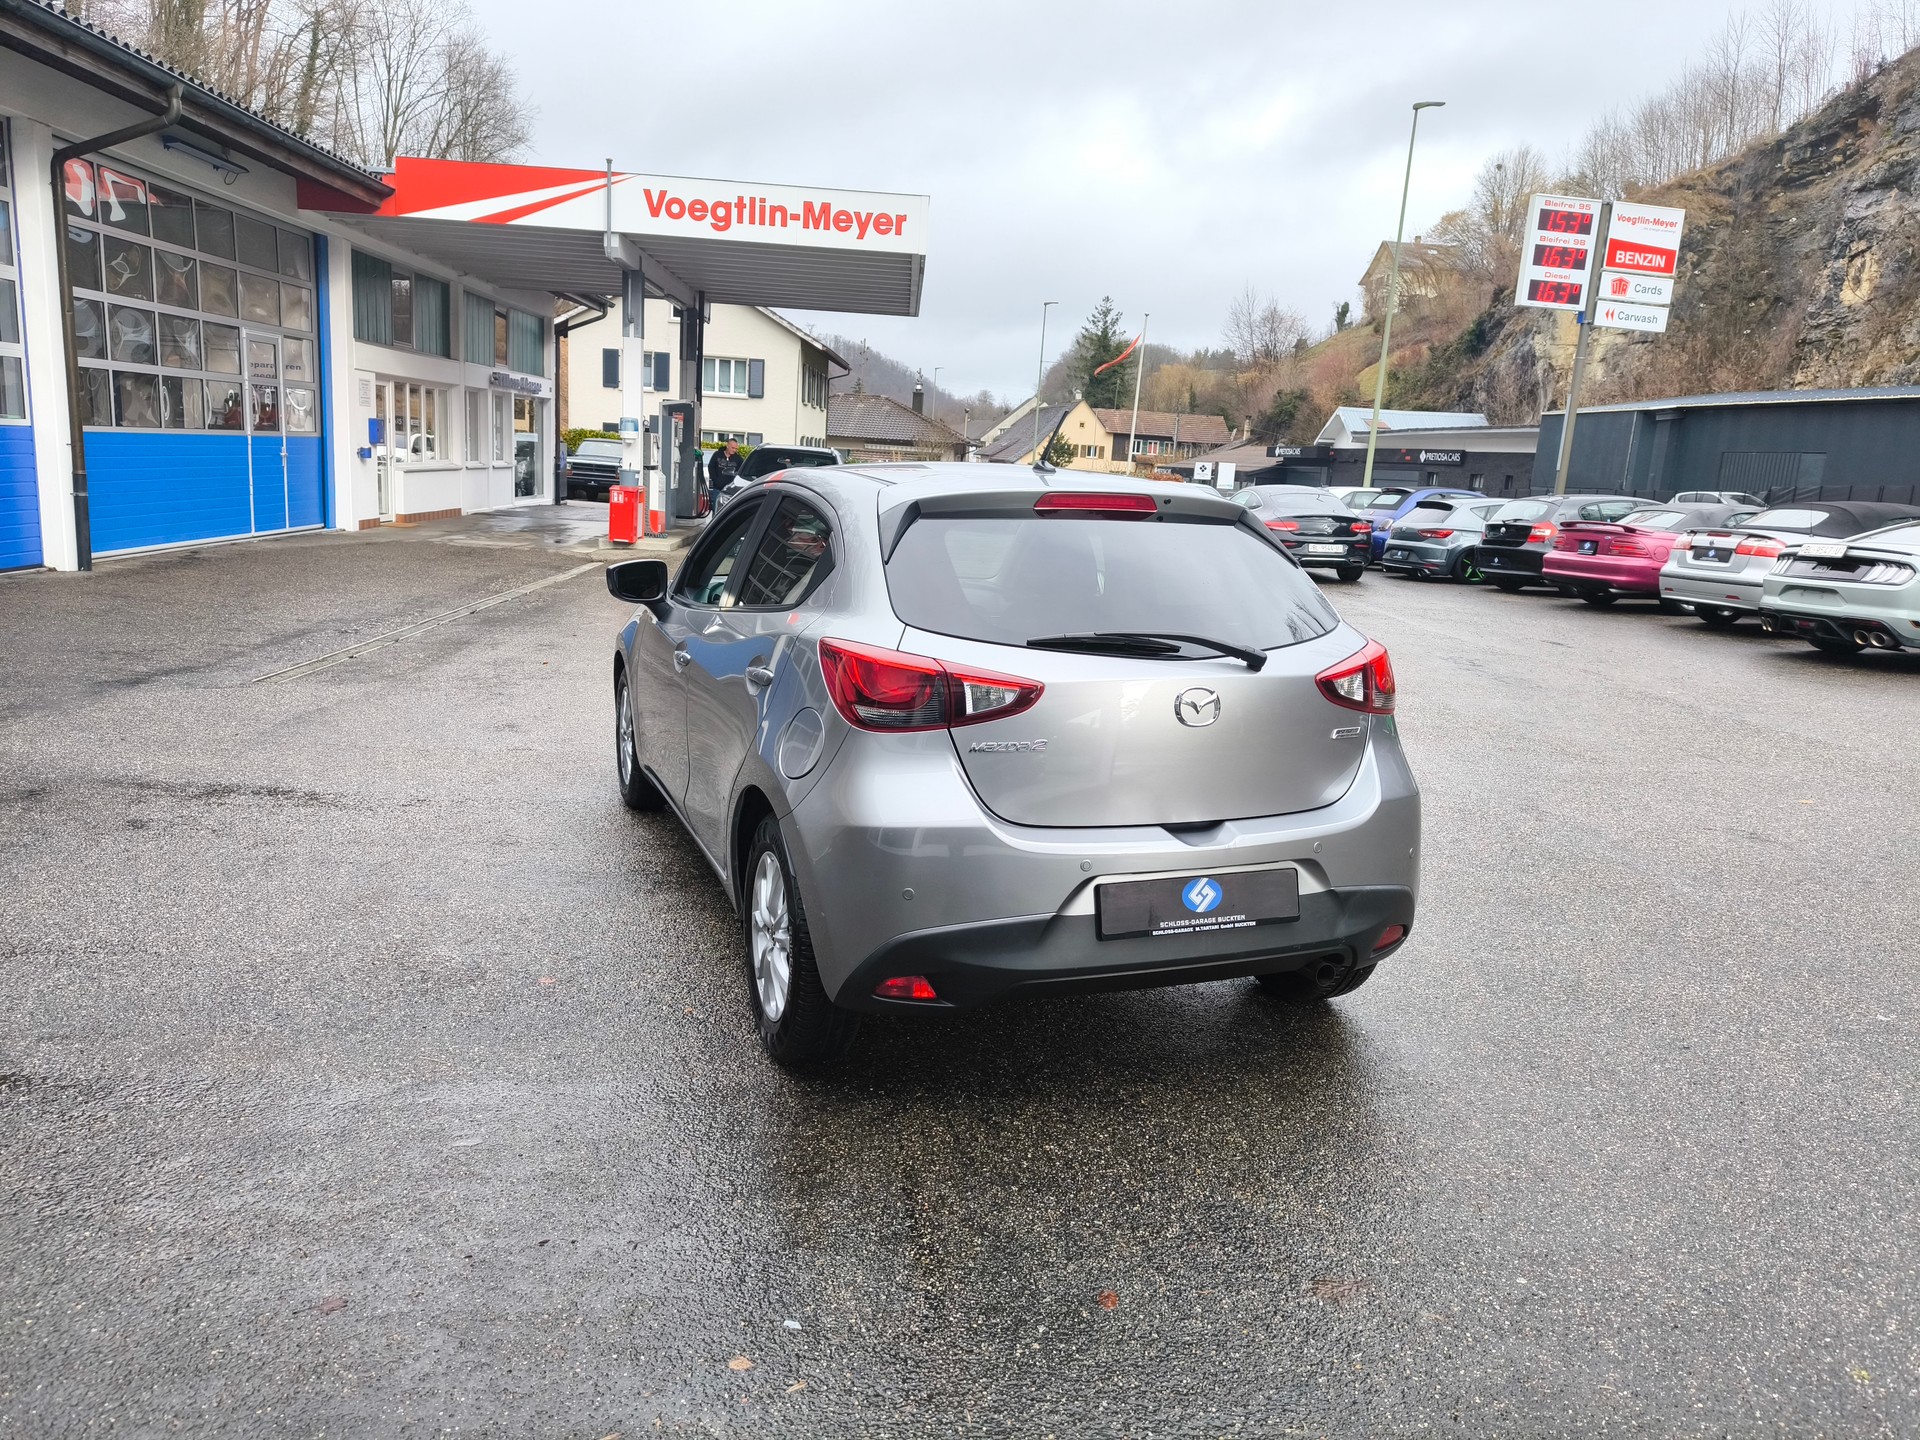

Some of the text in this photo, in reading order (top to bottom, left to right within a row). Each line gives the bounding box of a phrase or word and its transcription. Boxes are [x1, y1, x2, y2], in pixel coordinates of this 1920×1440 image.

[1544, 199, 1592, 211] Bleifrei 95
[642, 188, 908, 240] Voegtlin-Meyer
[1616, 213, 1678, 229] Voegtlin-Meyer
[1539, 235, 1587, 246] Bleifrei 98
[1615, 250, 1666, 268] BENZIN
[1544, 271, 1571, 280] Diesel
[1634, 283, 1662, 296] Cards
[1617, 311, 1658, 324] Carwash
[1448, 453, 1461, 462] CARS
[1160, 914, 1246, 928] SCHLOSS-GARAGE BUCKTEN
[1152, 927, 1194, 936] SCHLOSS-GARAGE
[1234, 921, 1257, 929] BUCKTEN
